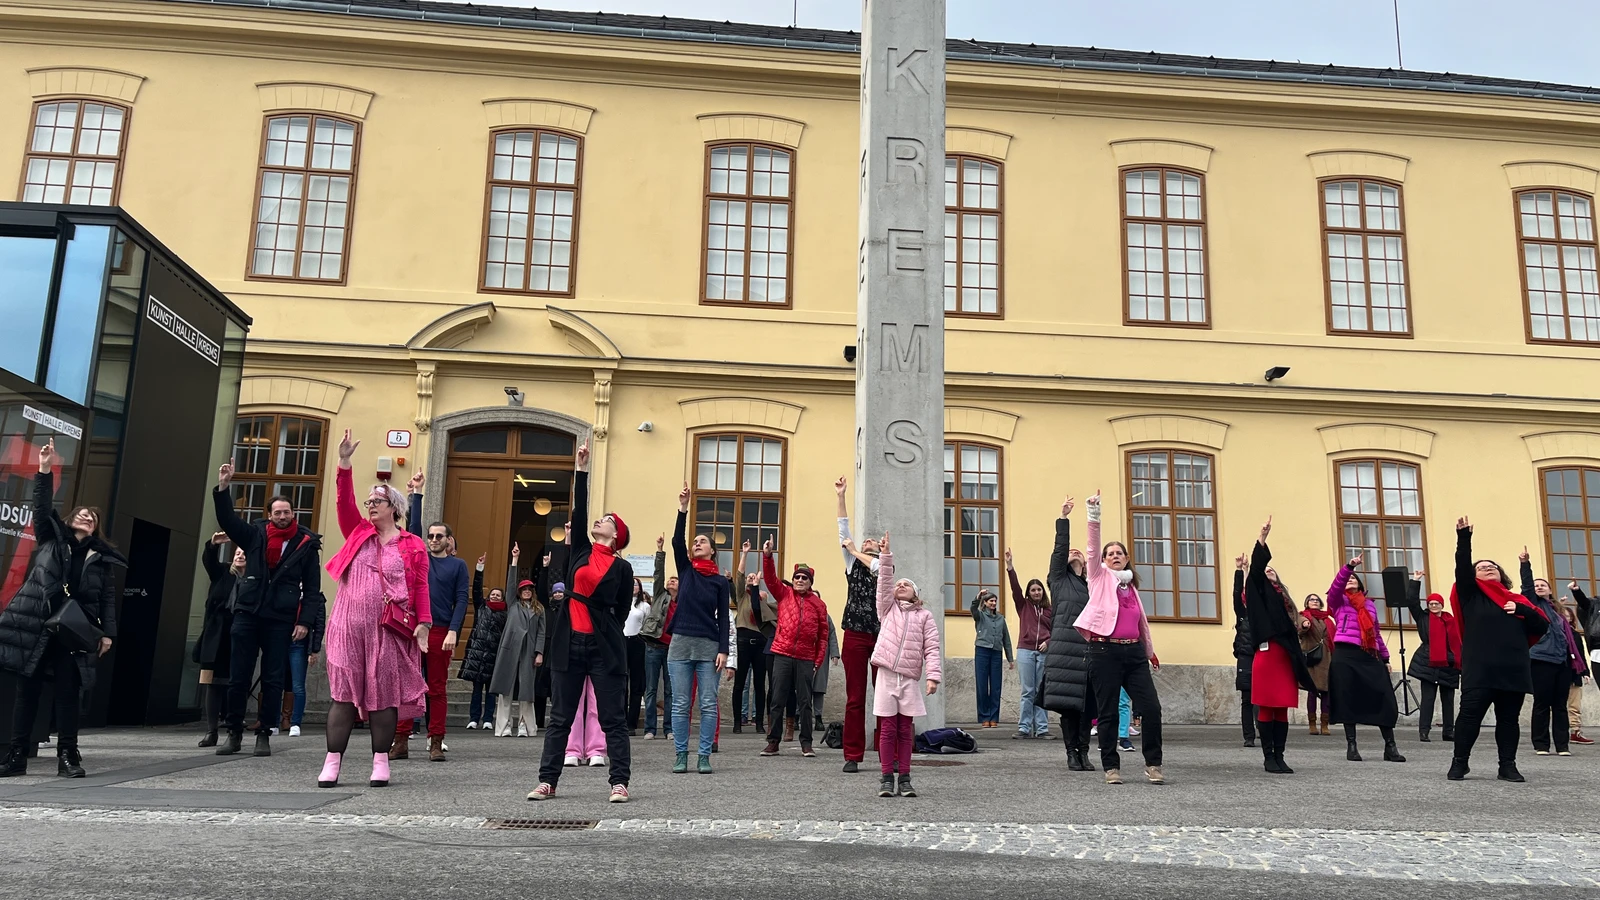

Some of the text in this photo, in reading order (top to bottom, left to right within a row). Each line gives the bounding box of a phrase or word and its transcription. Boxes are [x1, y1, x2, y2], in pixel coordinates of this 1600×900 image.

[880, 46, 930, 470] KREMS
[150, 302, 218, 360] KUNST HALLE KREMS
[24, 407, 81, 438] KUNST HALLE KREMS
[395, 432, 403, 442] 5
[0, 503, 33, 527] DSÜ
